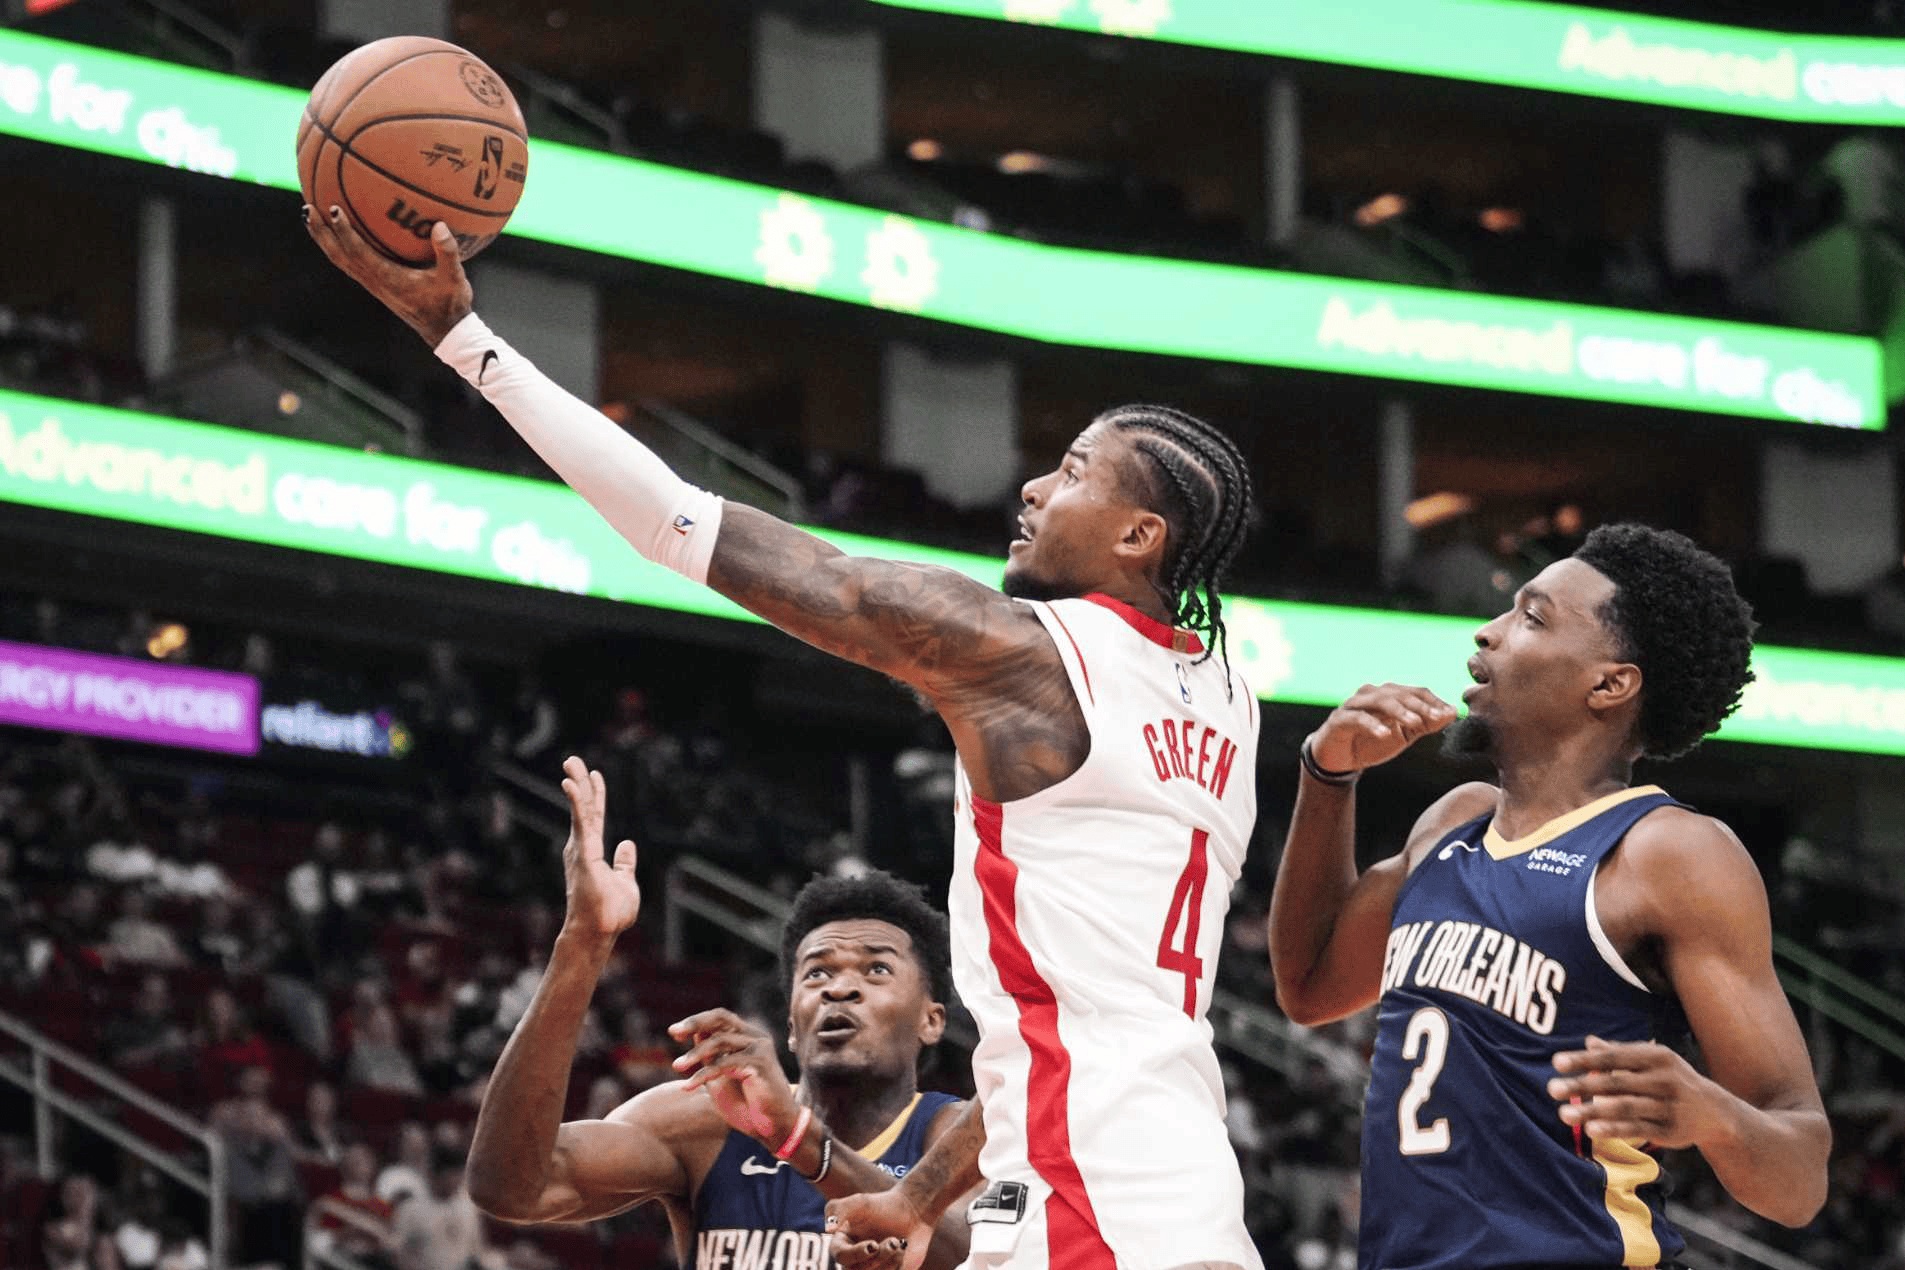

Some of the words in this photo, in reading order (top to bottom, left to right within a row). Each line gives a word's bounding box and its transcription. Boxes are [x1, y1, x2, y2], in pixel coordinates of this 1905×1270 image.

[73, 673, 243, 732] PROVIDER
[1143, 718, 1238, 801] GREEN
[1526, 861, 1571, 876] GARAGE
[1157, 828, 1208, 1020] 4
[1414, 920, 1567, 1035] ORLEANS
[1400, 1008, 1451, 1156] 2
